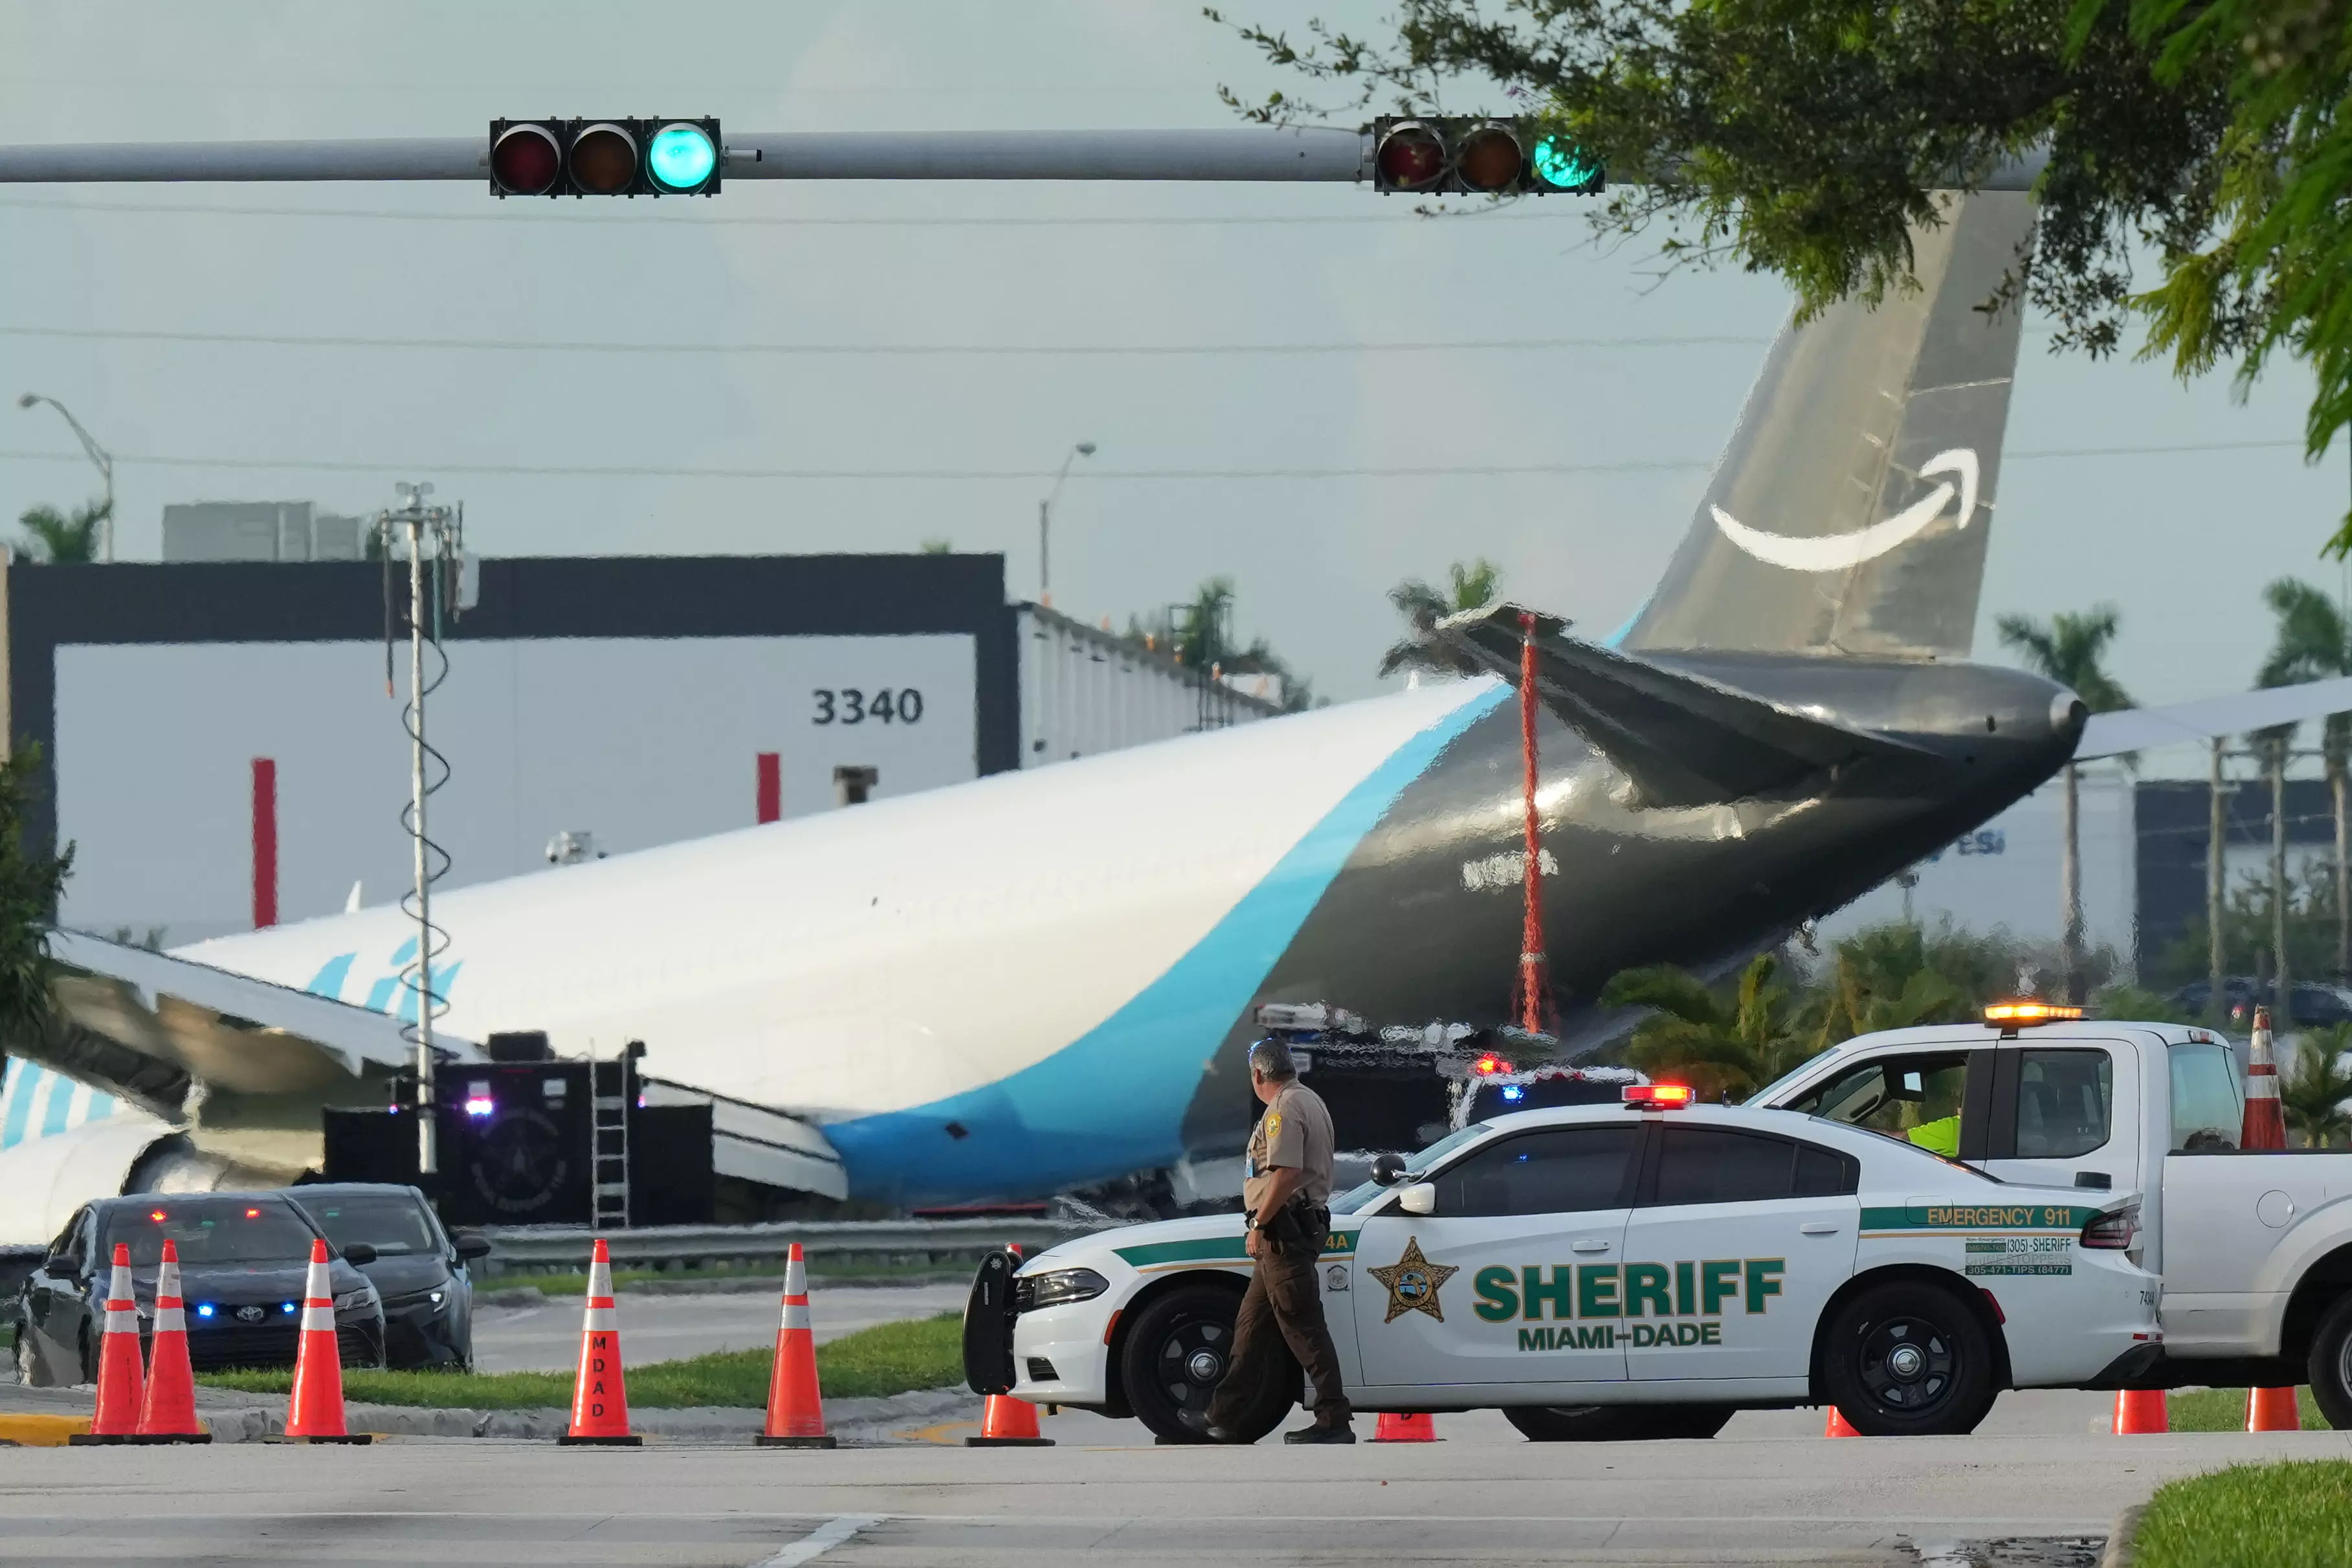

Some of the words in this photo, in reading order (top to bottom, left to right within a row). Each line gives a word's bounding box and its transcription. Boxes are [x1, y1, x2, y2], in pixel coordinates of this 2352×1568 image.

[812, 688, 924, 725] 3340
[1927, 1208, 2035, 1226] EMERGENCY
[2044, 1207, 2070, 1226] 911
[1968, 1265, 2035, 1274] 305-471-TIPS
[2038, 1265, 2069, 1274] (8477)
[1472, 1257, 1786, 1323] SHERIFF
[1517, 1321, 1722, 1351] MIAMI-DADE
[592, 1336, 606, 1417] MDAD
